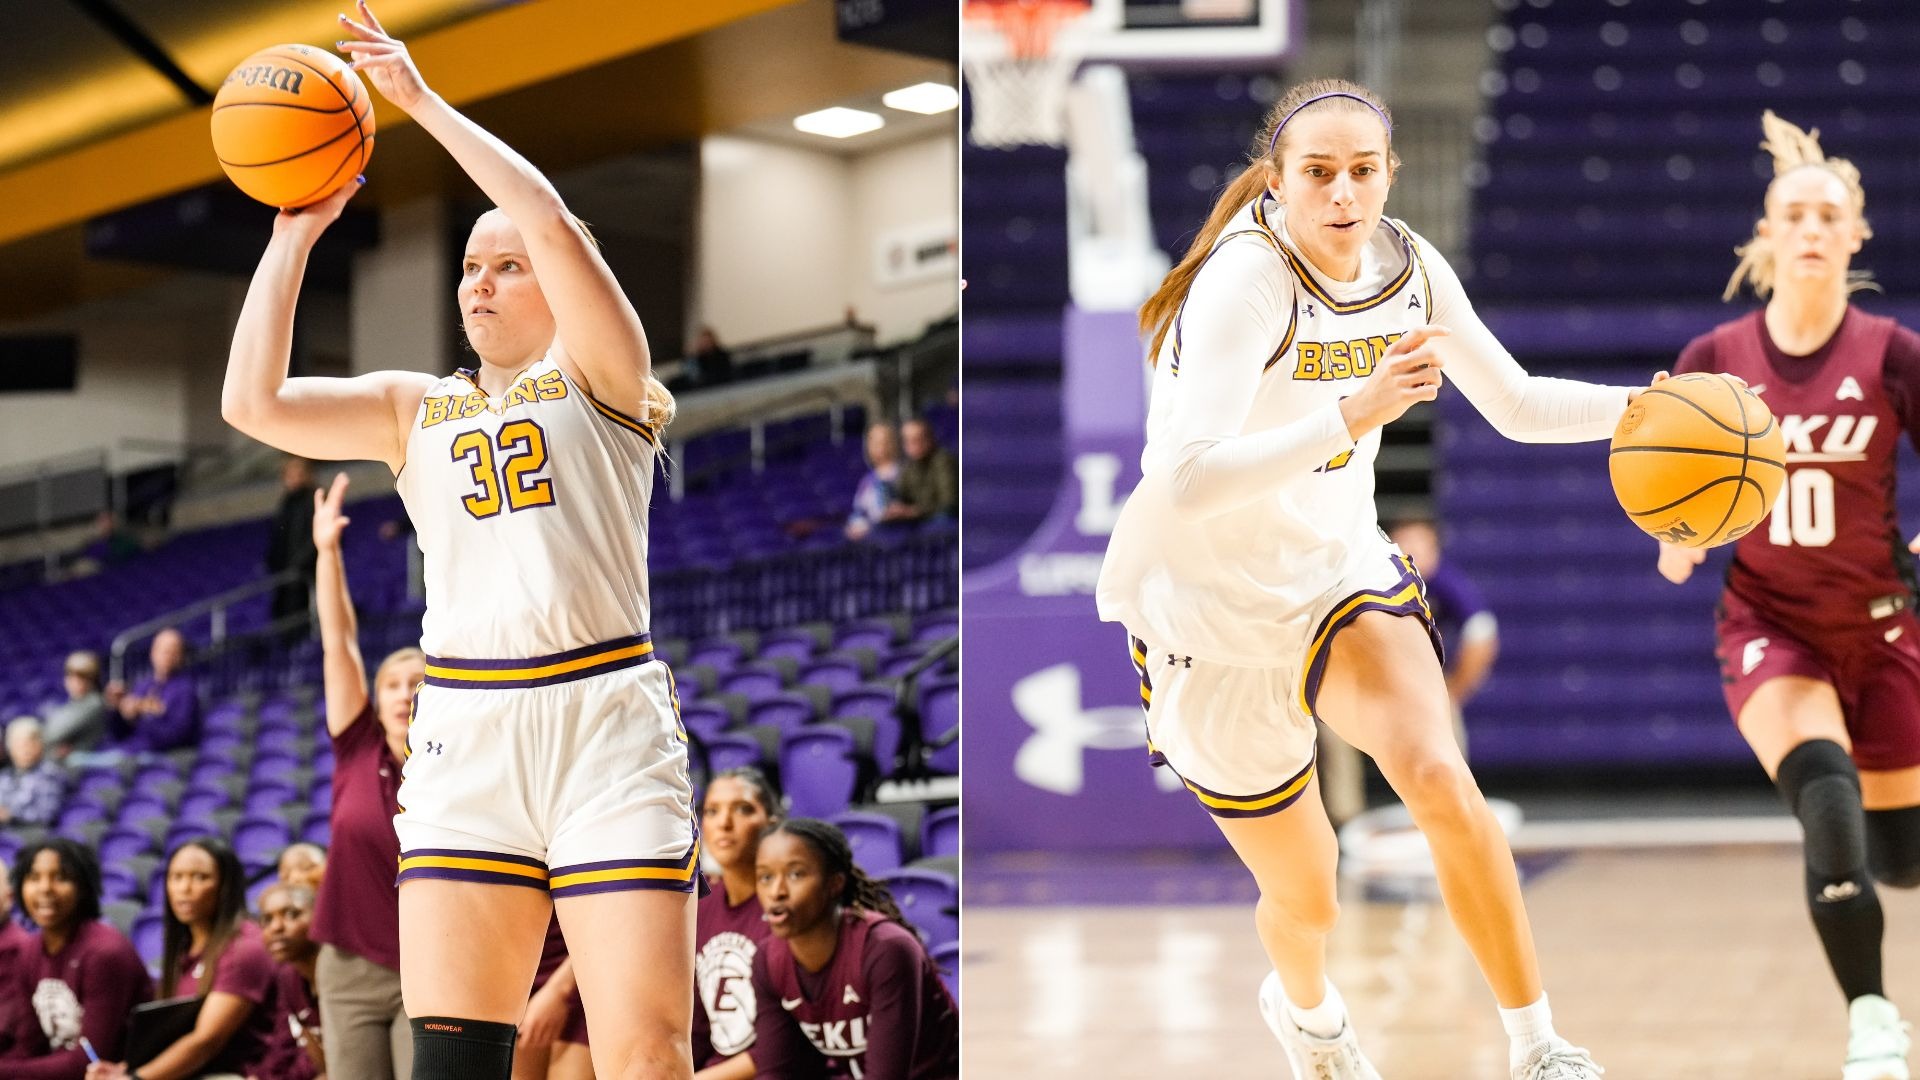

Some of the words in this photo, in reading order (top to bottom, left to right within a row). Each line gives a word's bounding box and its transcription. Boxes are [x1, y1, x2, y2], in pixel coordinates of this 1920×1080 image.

[1293, 331, 1408, 381] BISON
[422, 369, 568, 429] BISNS
[1778, 414, 1879, 453] KU
[450, 418, 556, 520] 32
[1769, 468, 1836, 547] 10
